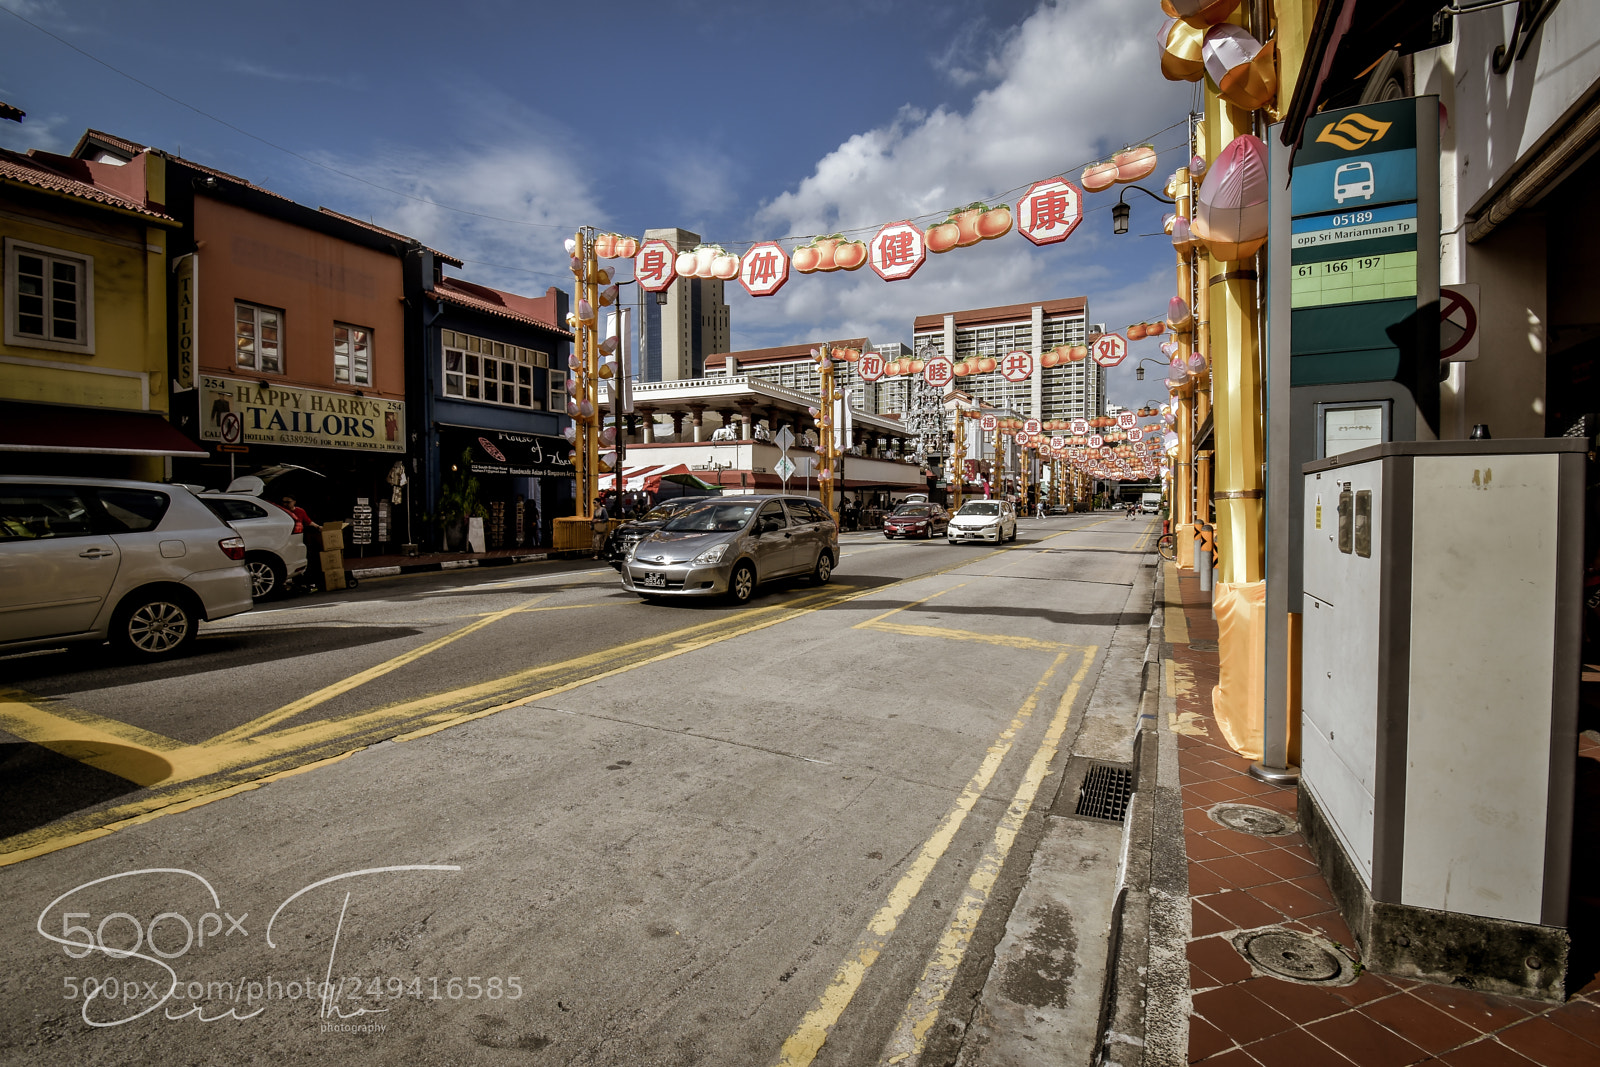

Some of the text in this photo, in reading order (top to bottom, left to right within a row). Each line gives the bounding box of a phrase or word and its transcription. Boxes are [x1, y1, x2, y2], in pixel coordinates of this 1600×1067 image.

[1333, 211, 1373, 226] 05189
[639, 189, 1069, 285] 身 体 健 康
[1298, 222, 1410, 245] opp Sri Mariamman Tp
[1298, 257, 1380, 277] 61 166 197
[181, 277, 191, 379] TAILORS
[862, 339, 1121, 381] 和 睦 共 处
[205, 378, 225, 389] 254
[236, 386, 380, 418] HAPPY HARRY'S
[387, 402, 401, 411] 254
[247, 406, 374, 438] TAILORS
[244, 433, 274, 441] HOTLINE
